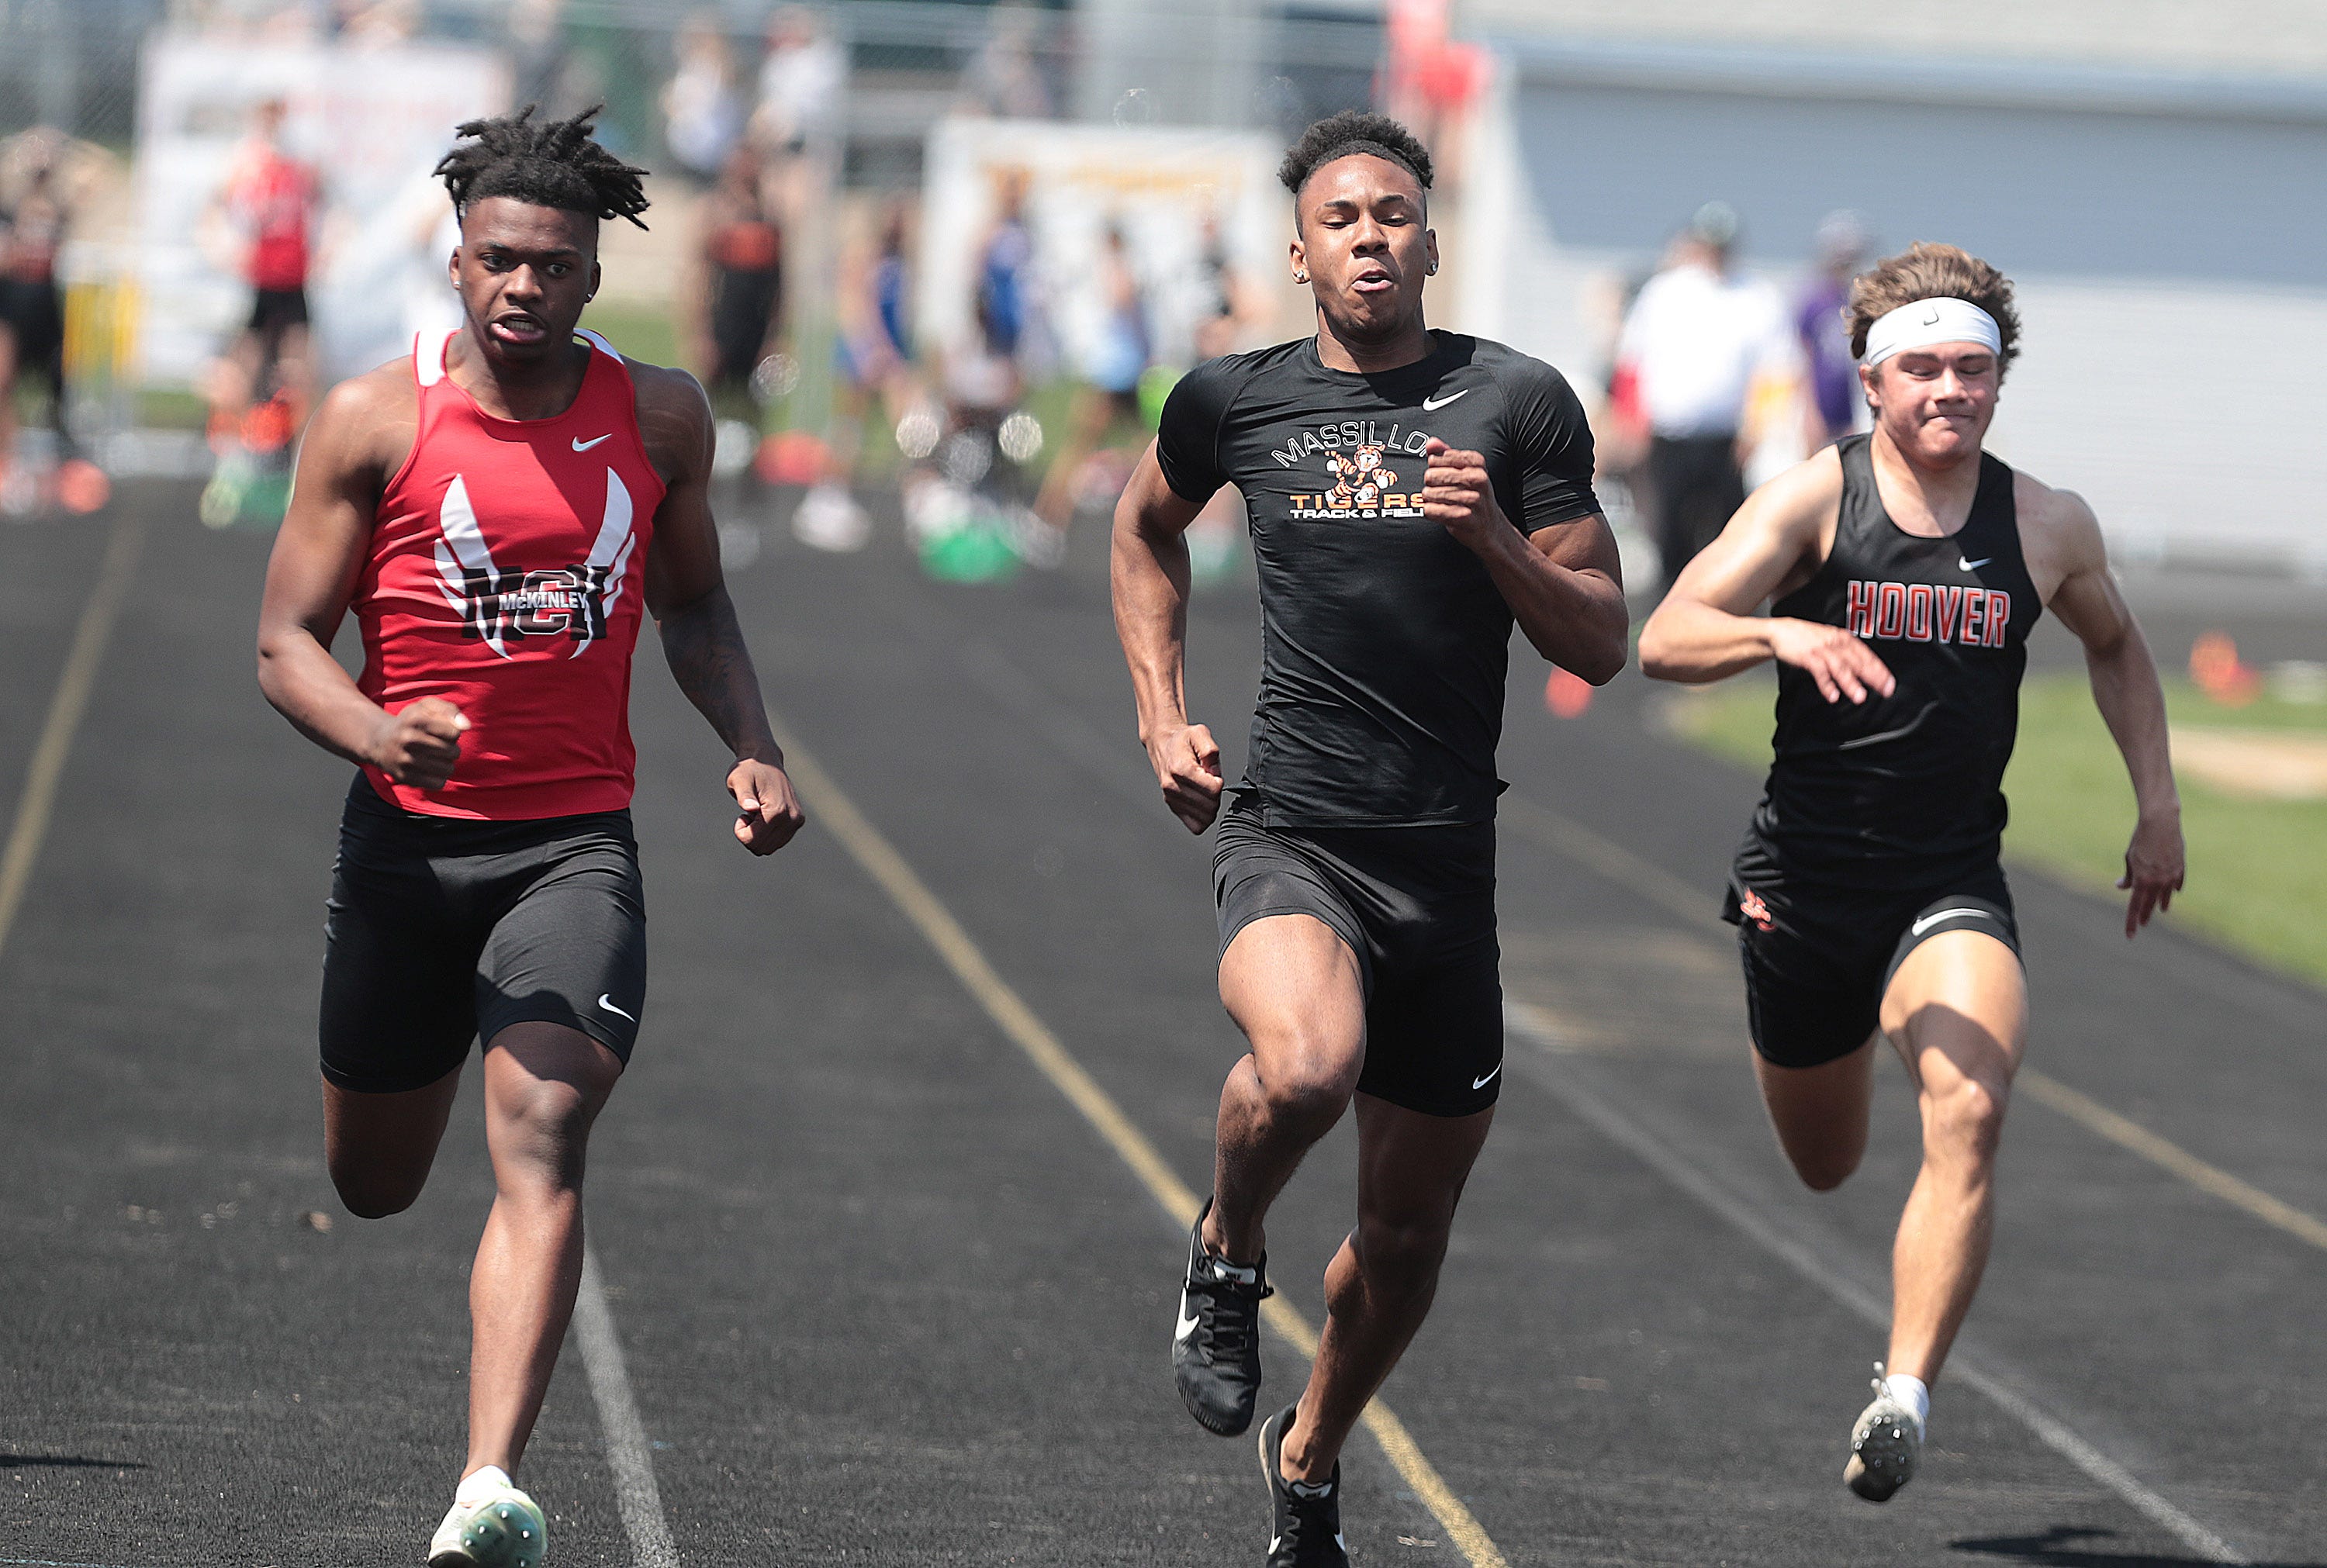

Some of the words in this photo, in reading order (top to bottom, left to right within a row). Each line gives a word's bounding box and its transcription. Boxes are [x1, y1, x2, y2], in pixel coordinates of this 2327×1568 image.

[1271, 420, 1430, 468] MASSILLO
[1289, 509, 1361, 519] TRACK
[1361, 509, 1378, 519] &
[1846, 580, 2011, 648] HOOVER
